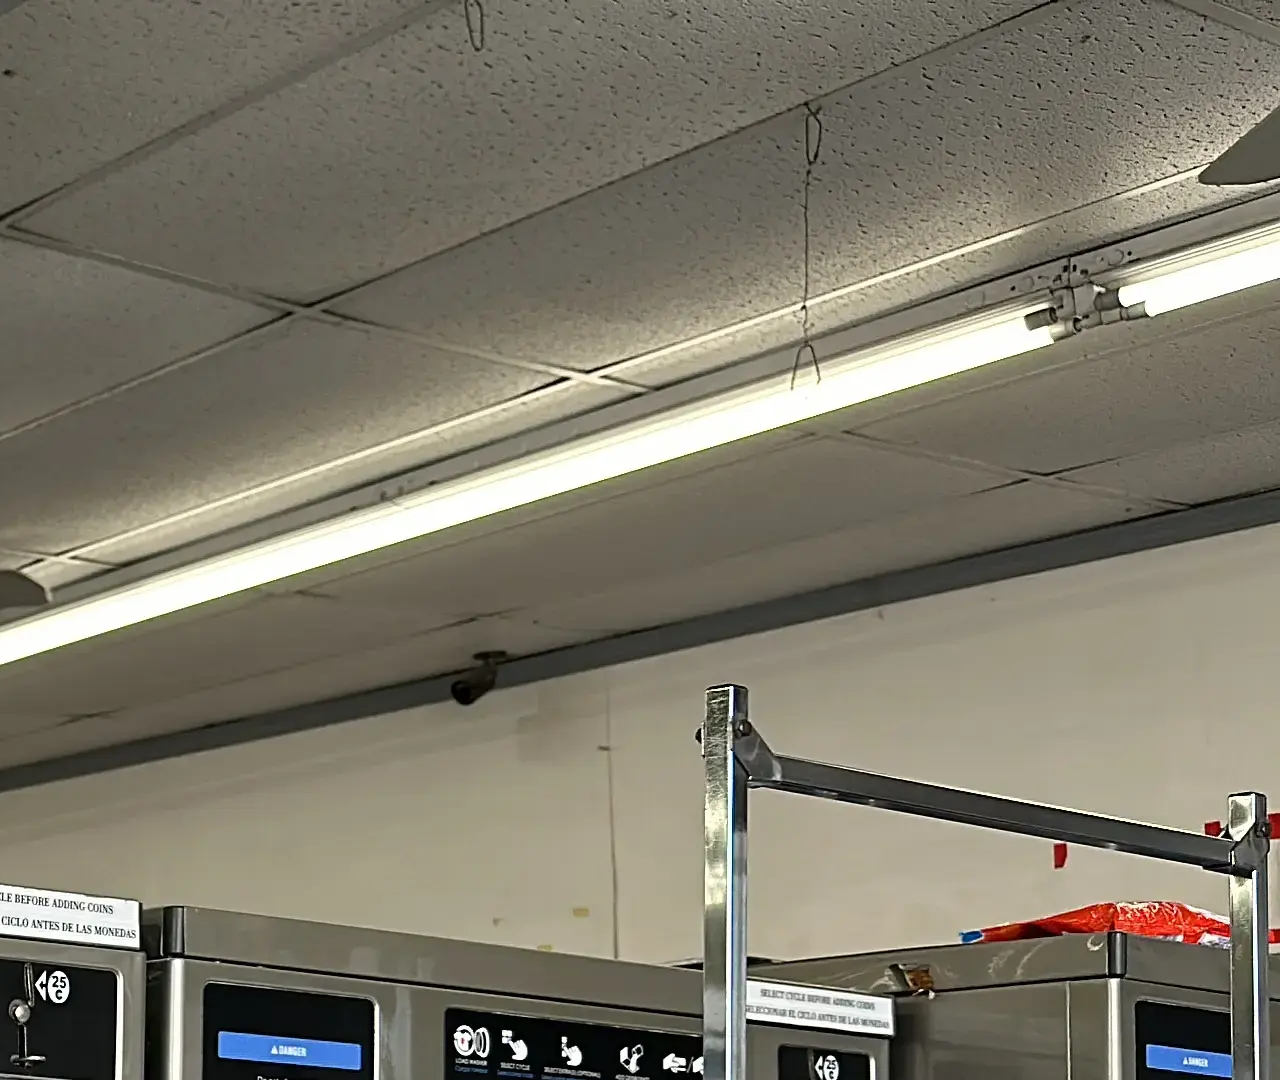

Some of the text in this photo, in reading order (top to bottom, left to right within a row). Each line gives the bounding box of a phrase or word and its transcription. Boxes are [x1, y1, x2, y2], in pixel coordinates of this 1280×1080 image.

[15, 894, 49, 907] BEFORE
[52, 899, 85, 911] ADDING
[88, 903, 113, 914] COINS
[2, 916, 29, 928] CICLO
[32, 920, 59, 931] ANTES
[62, 923, 73, 932] DE
[76, 924, 92, 934] LAS
[95, 926, 136, 938] MONEDAS
[52, 976, 66, 988] 25
